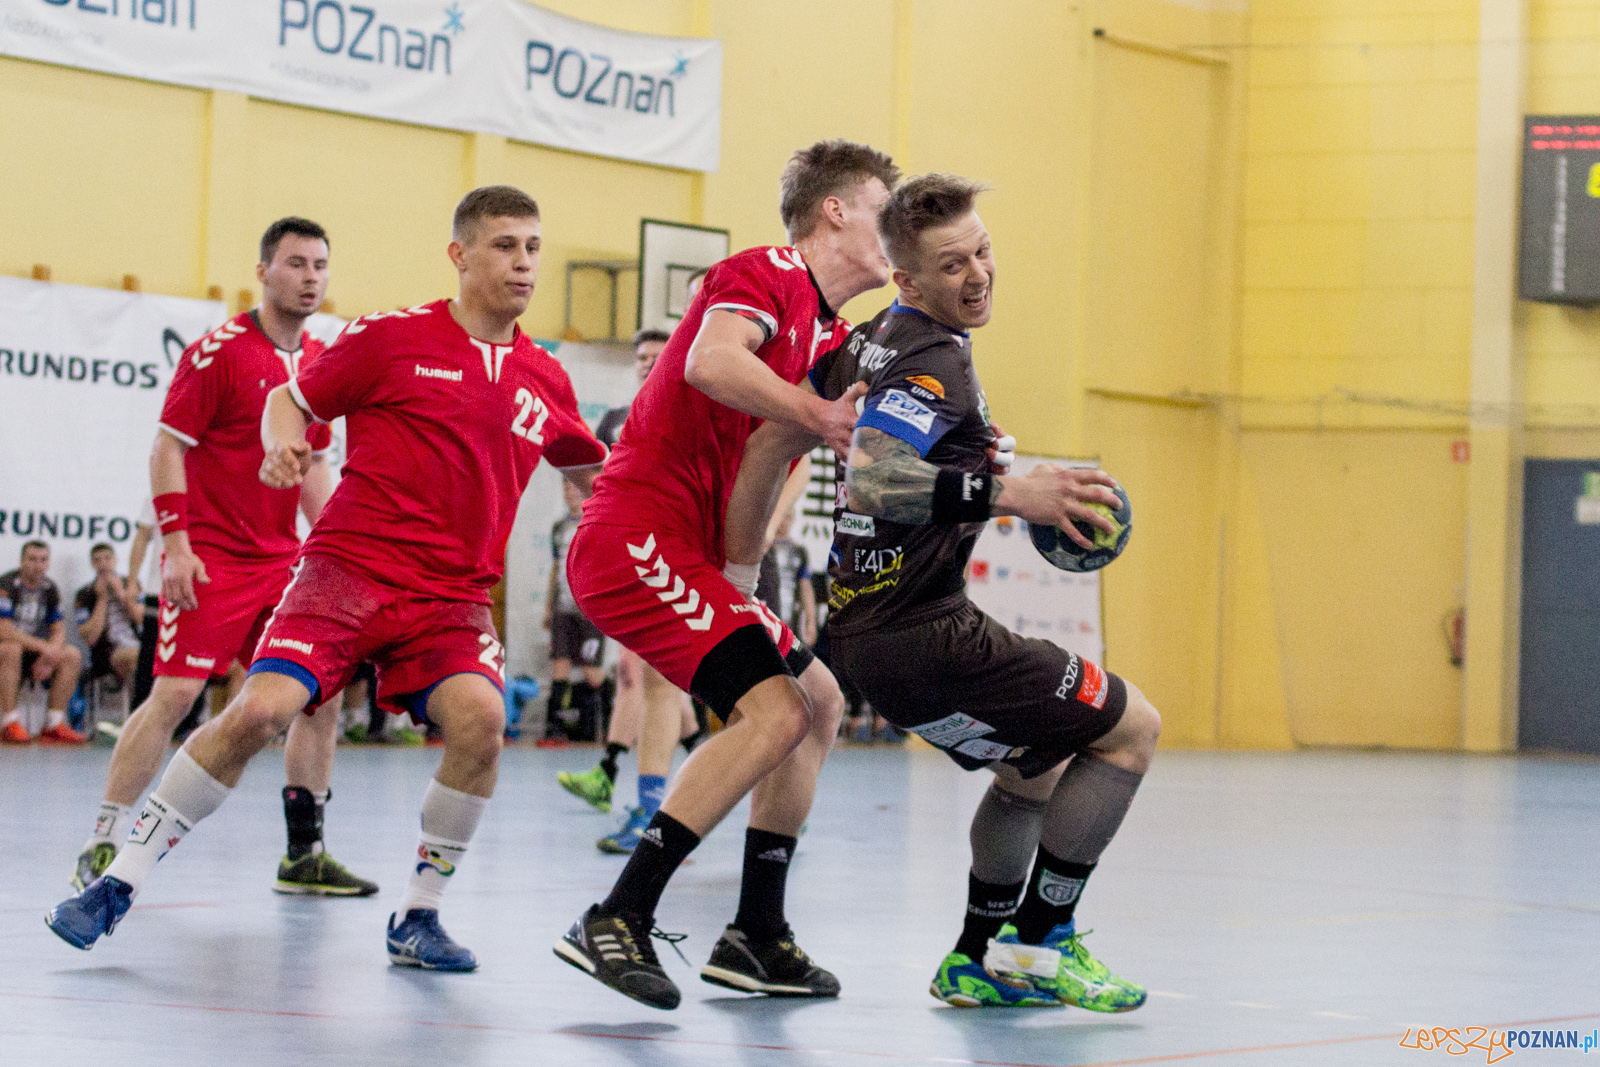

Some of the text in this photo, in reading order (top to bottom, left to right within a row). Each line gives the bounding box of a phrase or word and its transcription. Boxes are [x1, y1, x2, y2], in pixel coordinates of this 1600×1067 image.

[415, 364, 463, 382] hummel
[511, 387, 549, 446] 22
[269, 637, 314, 655] hummel
